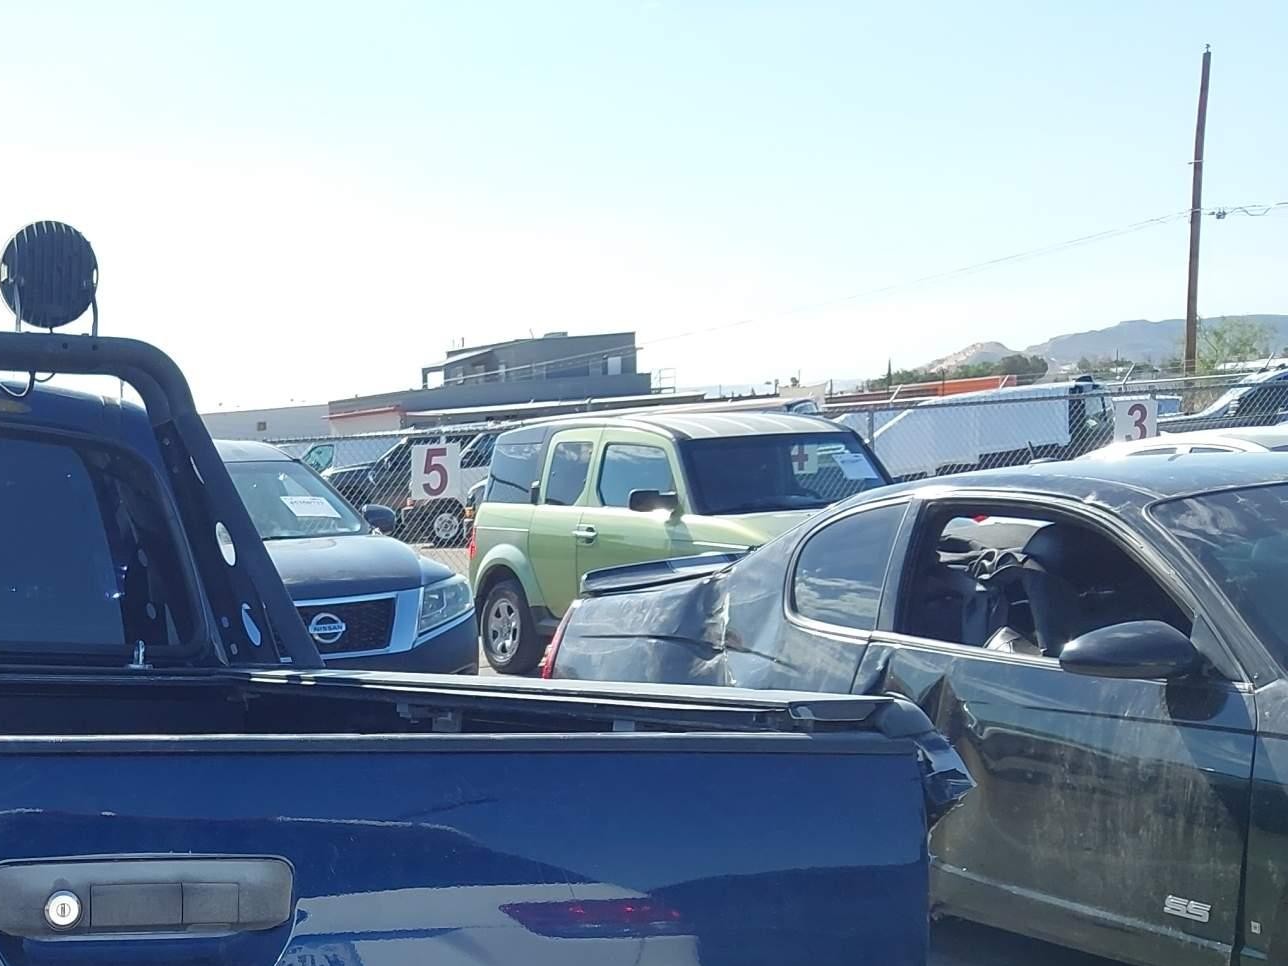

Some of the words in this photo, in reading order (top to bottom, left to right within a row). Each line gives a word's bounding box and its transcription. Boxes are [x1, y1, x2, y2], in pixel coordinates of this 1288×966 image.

[1125, 403, 1148, 440] 3
[422, 447, 449, 497] 5
[313, 624, 343, 632] NISSAN
[1163, 894, 1212, 923] SS
